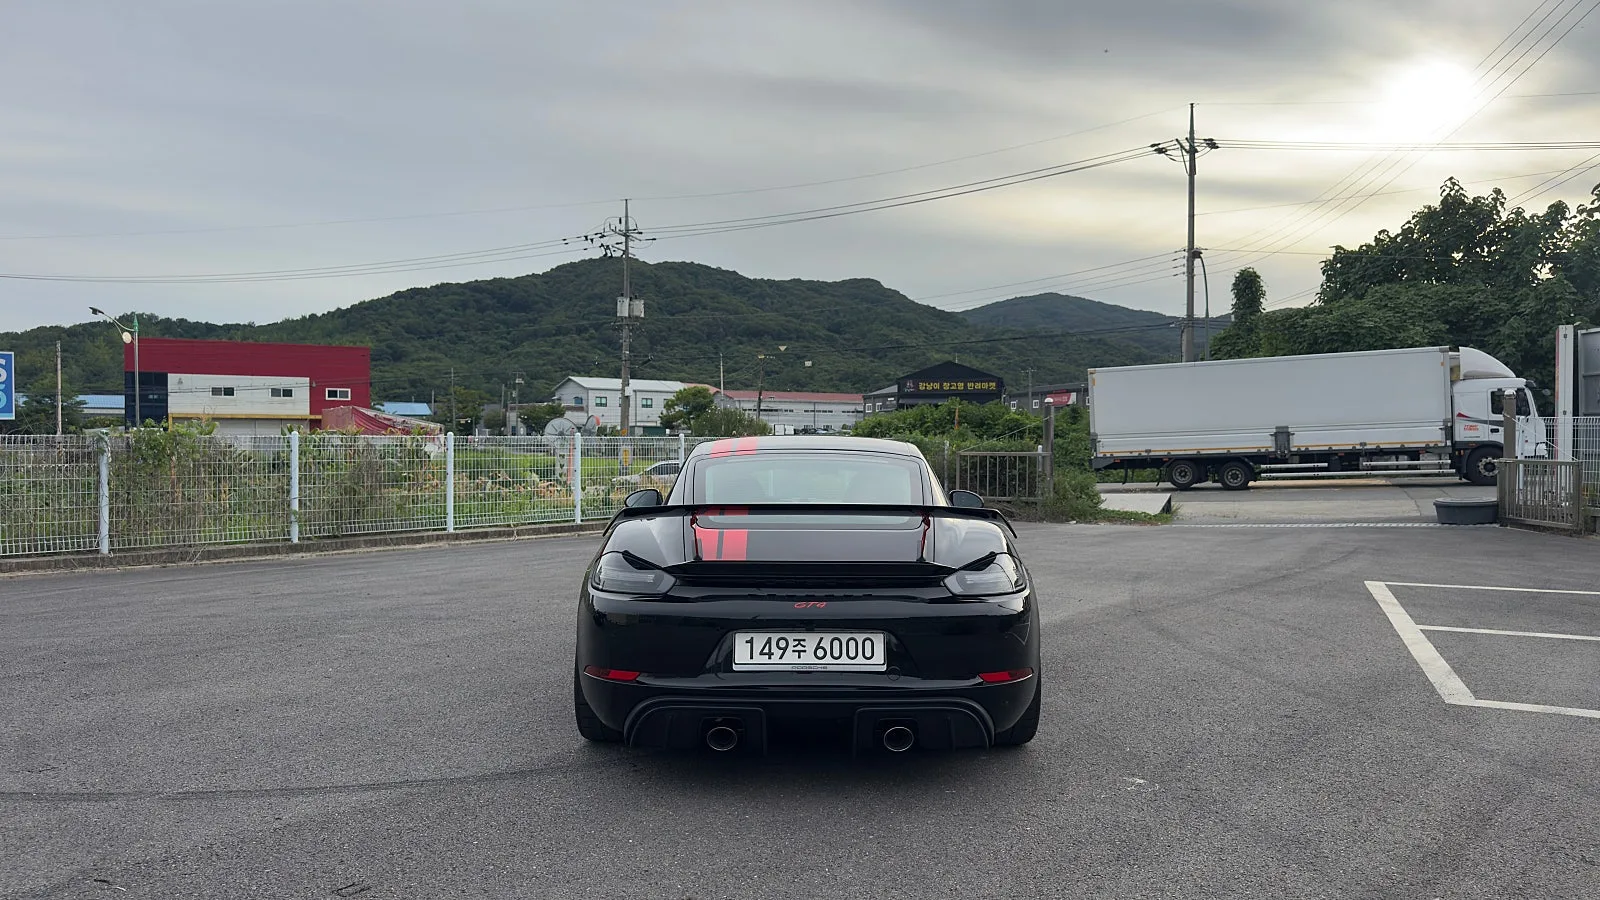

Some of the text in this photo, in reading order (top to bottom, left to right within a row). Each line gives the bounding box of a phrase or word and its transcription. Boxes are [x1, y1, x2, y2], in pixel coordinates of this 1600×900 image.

[793, 601, 827, 609] GT4
[745, 637, 875, 660] 149주 6000
